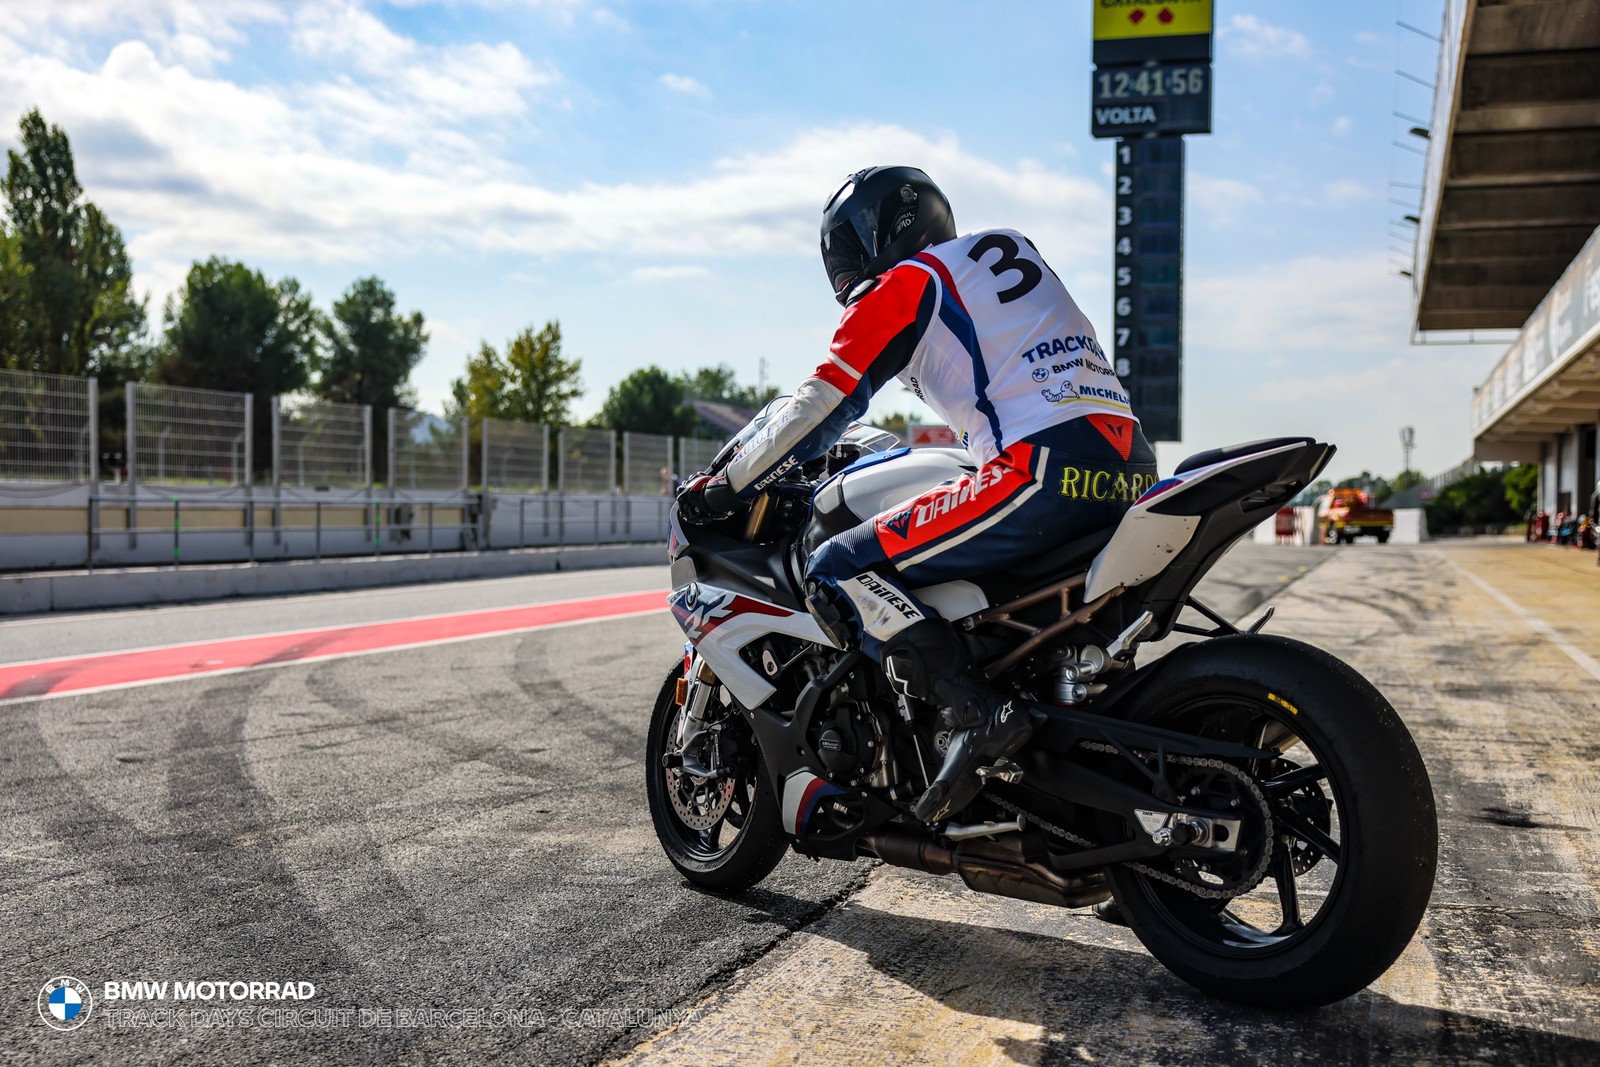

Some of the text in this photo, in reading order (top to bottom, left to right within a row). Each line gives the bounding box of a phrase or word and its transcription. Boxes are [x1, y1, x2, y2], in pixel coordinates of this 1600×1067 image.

[1095, 106, 1156, 124] VOLTA
[1119, 145, 1131, 164] 1
[1117, 175, 1132, 195] 2
[1117, 206, 1132, 225] 3
[1117, 236, 1132, 255] 4
[1117, 266, 1132, 286] 5
[1116, 297, 1132, 316] 6
[1116, 327, 1131, 347] 7
[1052, 358, 1083, 374] BMW
[1116, 357, 1131, 377] 8
